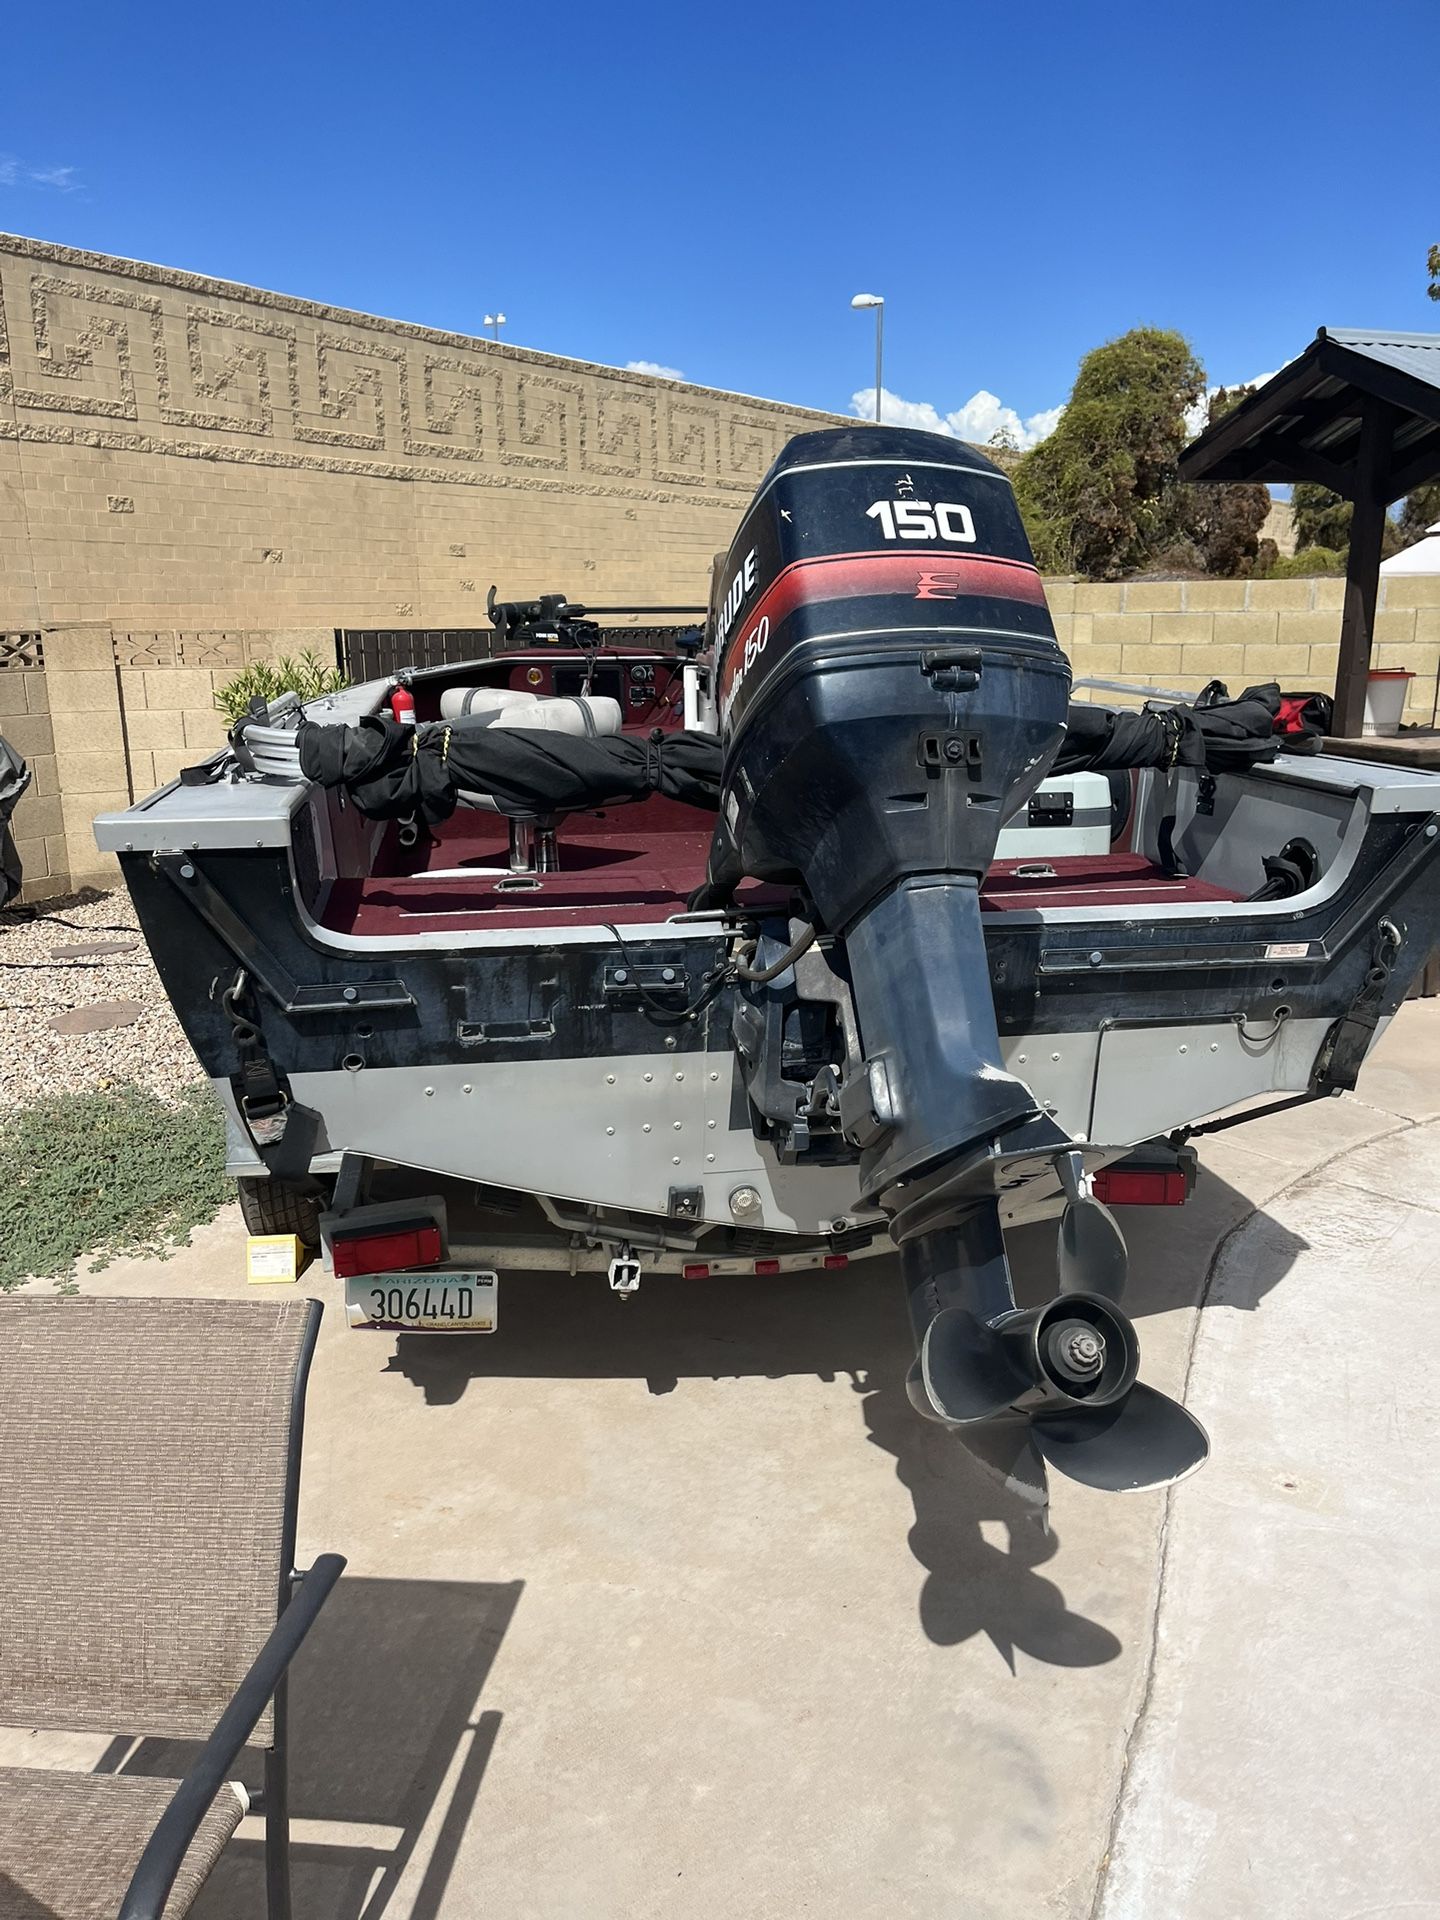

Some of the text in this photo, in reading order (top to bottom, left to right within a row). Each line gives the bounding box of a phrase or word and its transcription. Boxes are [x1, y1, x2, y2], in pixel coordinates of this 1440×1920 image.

[865, 500, 977, 543] 150
[744, 615, 769, 675] 150
[370, 1287, 473, 1320] 30644D
